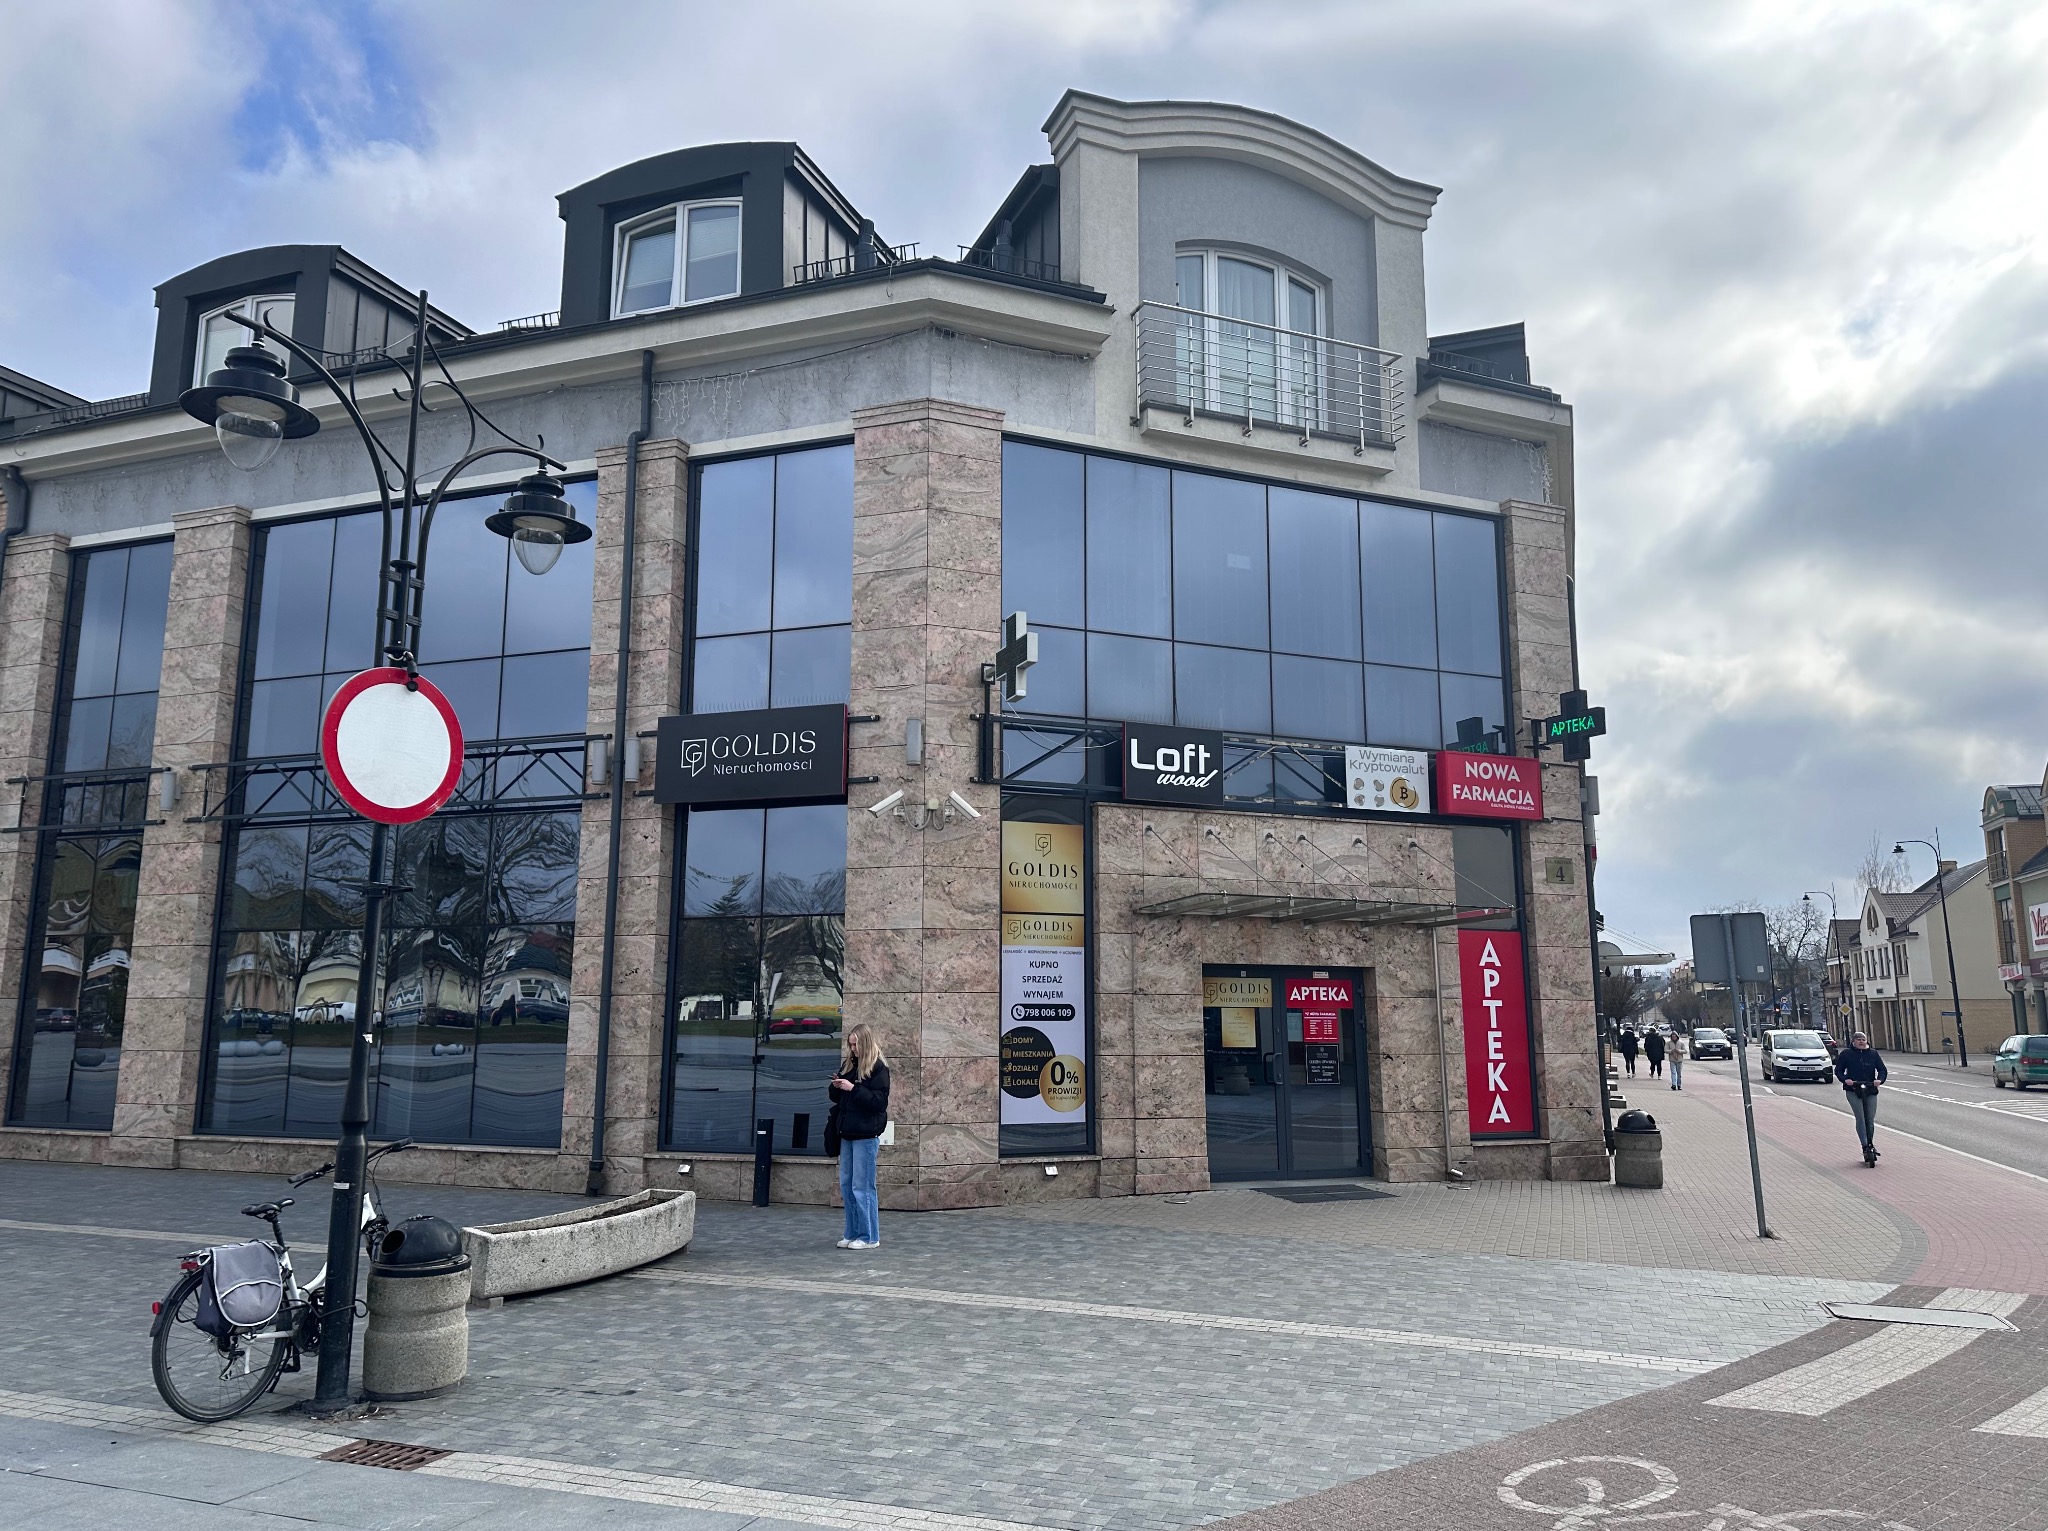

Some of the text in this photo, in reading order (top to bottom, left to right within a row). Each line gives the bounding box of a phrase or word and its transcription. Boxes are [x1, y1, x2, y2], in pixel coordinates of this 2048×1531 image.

[1551, 715, 1595, 736] APTEKA
[711, 730, 816, 759] GOLDIS
[1130, 738, 1211, 774] Loft
[1359, 750, 1414, 763] Wymiana
[713, 759, 812, 775] Nieruchomości
[1350, 759, 1425, 775] Kryptowalut
[1465, 761, 1520, 783] NOWA
[1156, 769, 1219, 788] wood
[1452, 784, 1534, 806] FARMACJA
[1008, 861, 1078, 878] GOLDIS
[1556, 866, 1565, 881] 4
[1009, 880, 1078, 890] NIERUCHOMOŚCI
[1023, 920, 1073, 932] GOLDIS
[1029, 960, 1059, 968] KUPNO
[1022, 974, 1063, 983] SPRZEDAŻ
[1023, 991, 1064, 1000] WYNAJEM
[1219, 982, 1269, 994] GOLDIS
[1290, 986, 1349, 1001] APTEKA
[1025, 1009, 1072, 1017] 798 006 109
[1478, 938, 1511, 1123] APTEKA
[1012, 1050, 1054, 1058] MIESZKANIA
[1012, 1064, 1038, 1072] DZIAŁKI
[1050, 1061, 1079, 1086] 0%
[1012, 1078, 1038, 1086] LOKALE
[1048, 1087, 1082, 1096] PROWIZJI
